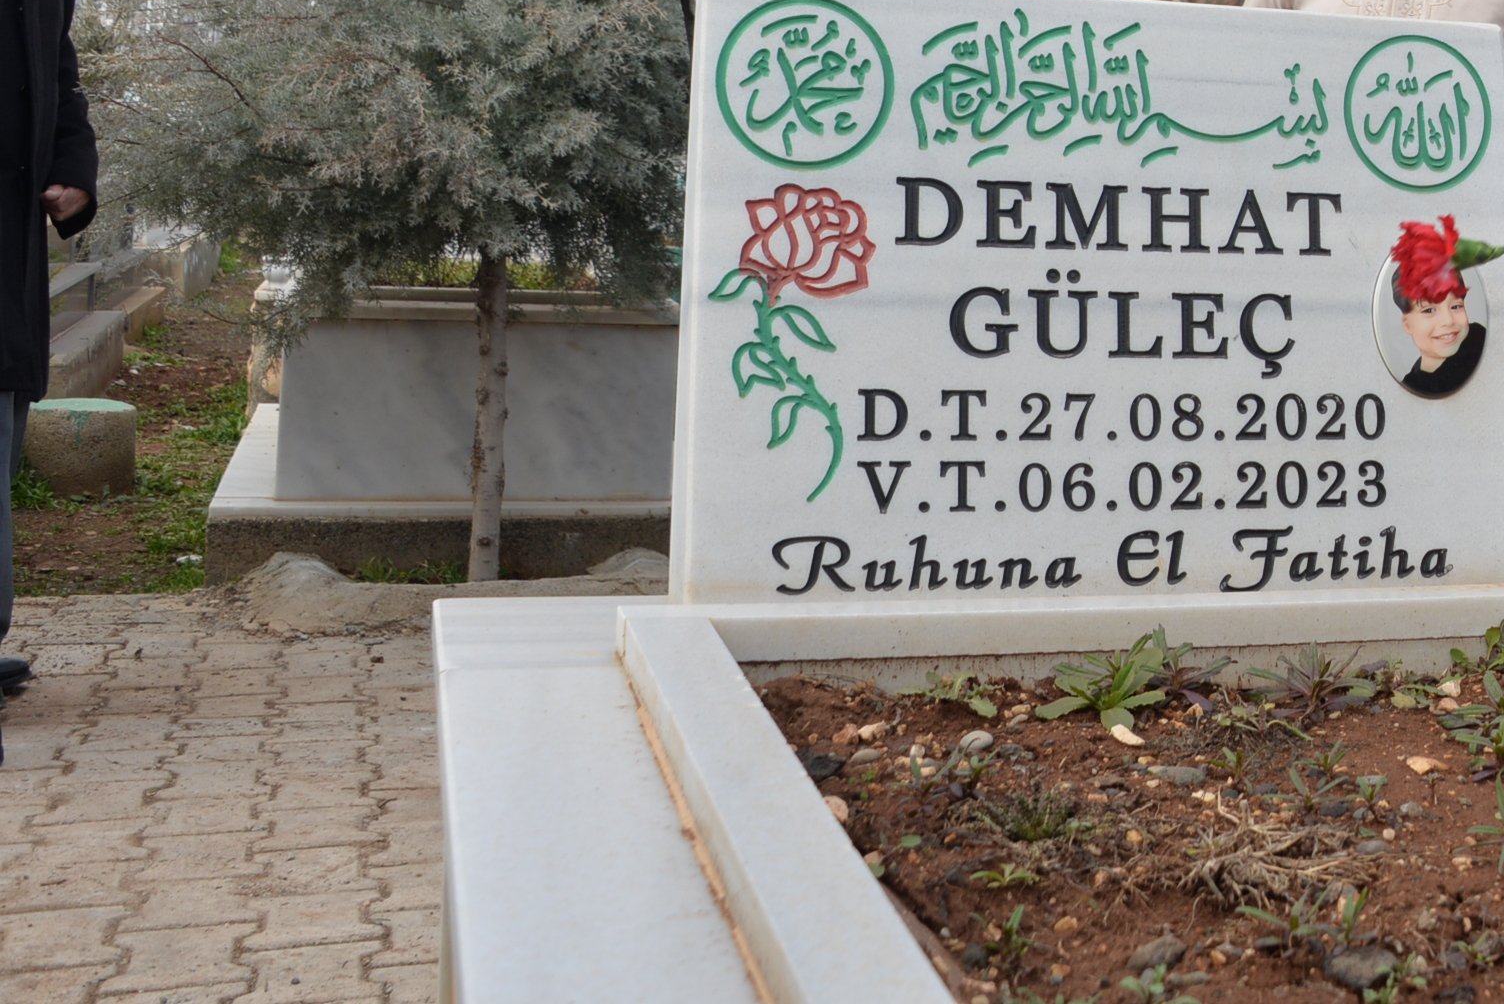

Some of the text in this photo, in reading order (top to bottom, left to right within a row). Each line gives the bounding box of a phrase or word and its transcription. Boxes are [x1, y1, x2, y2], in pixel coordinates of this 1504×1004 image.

[894, 176, 1342, 257] DEMHAT
[949, 268, 1296, 379] GÜLEÇ
[856, 388, 1386, 442] D.T.27.08.2020
[856, 459, 1388, 515] V.T.06.02.2023
[771, 525, 1455, 596] Ruhuna El Fatiha
